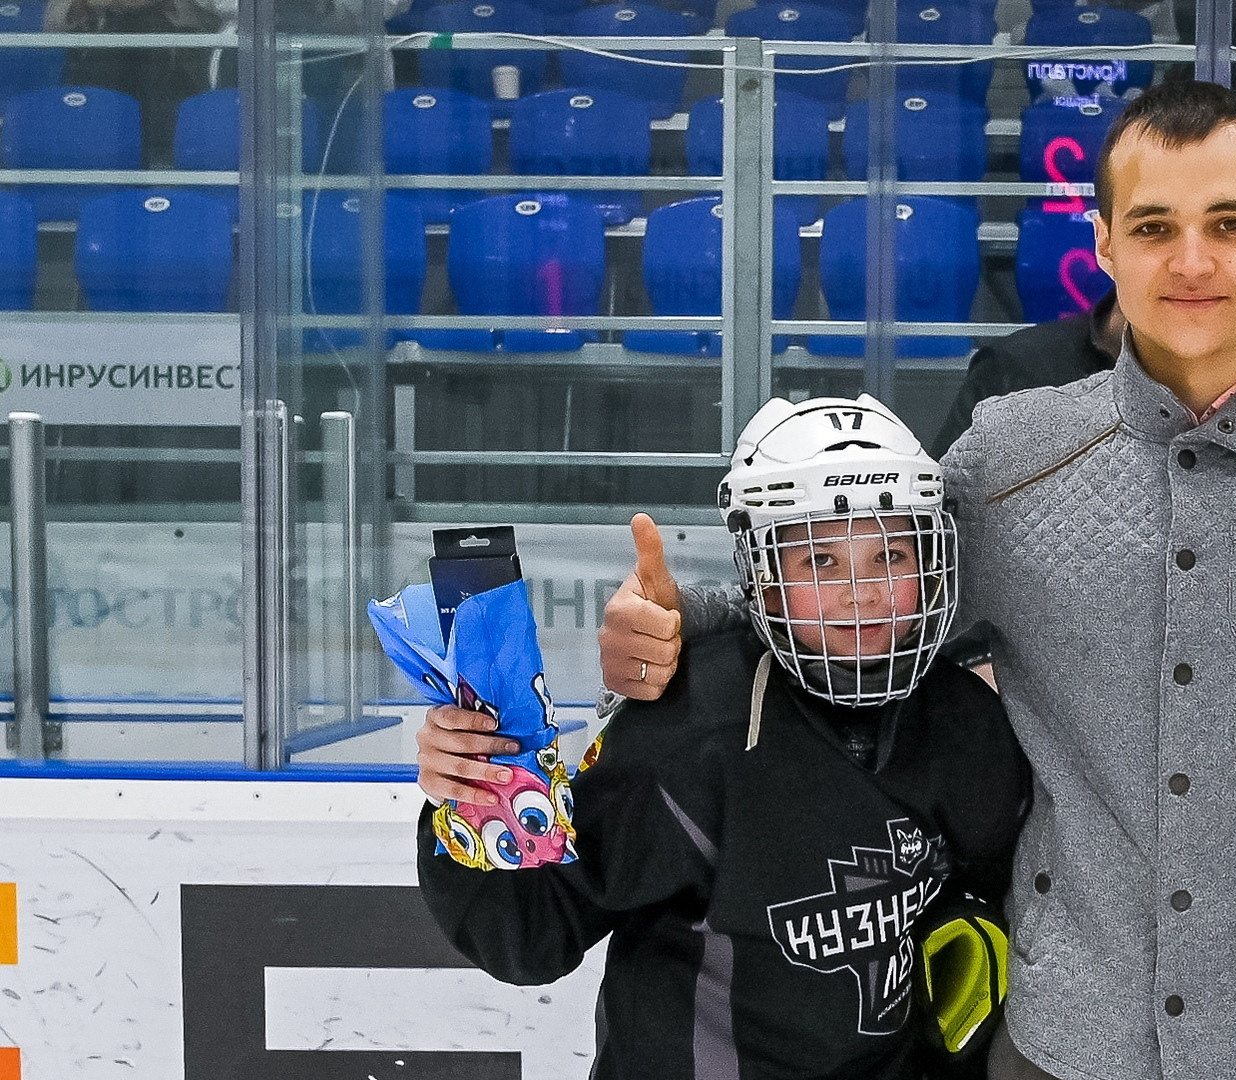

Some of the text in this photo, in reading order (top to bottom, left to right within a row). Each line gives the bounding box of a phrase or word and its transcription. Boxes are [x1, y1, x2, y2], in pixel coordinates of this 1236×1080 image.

[21, 363, 242, 389] ИНРУСИНВЕС
[824, 411, 863, 430] 17
[823, 472, 900, 488] BAUER
